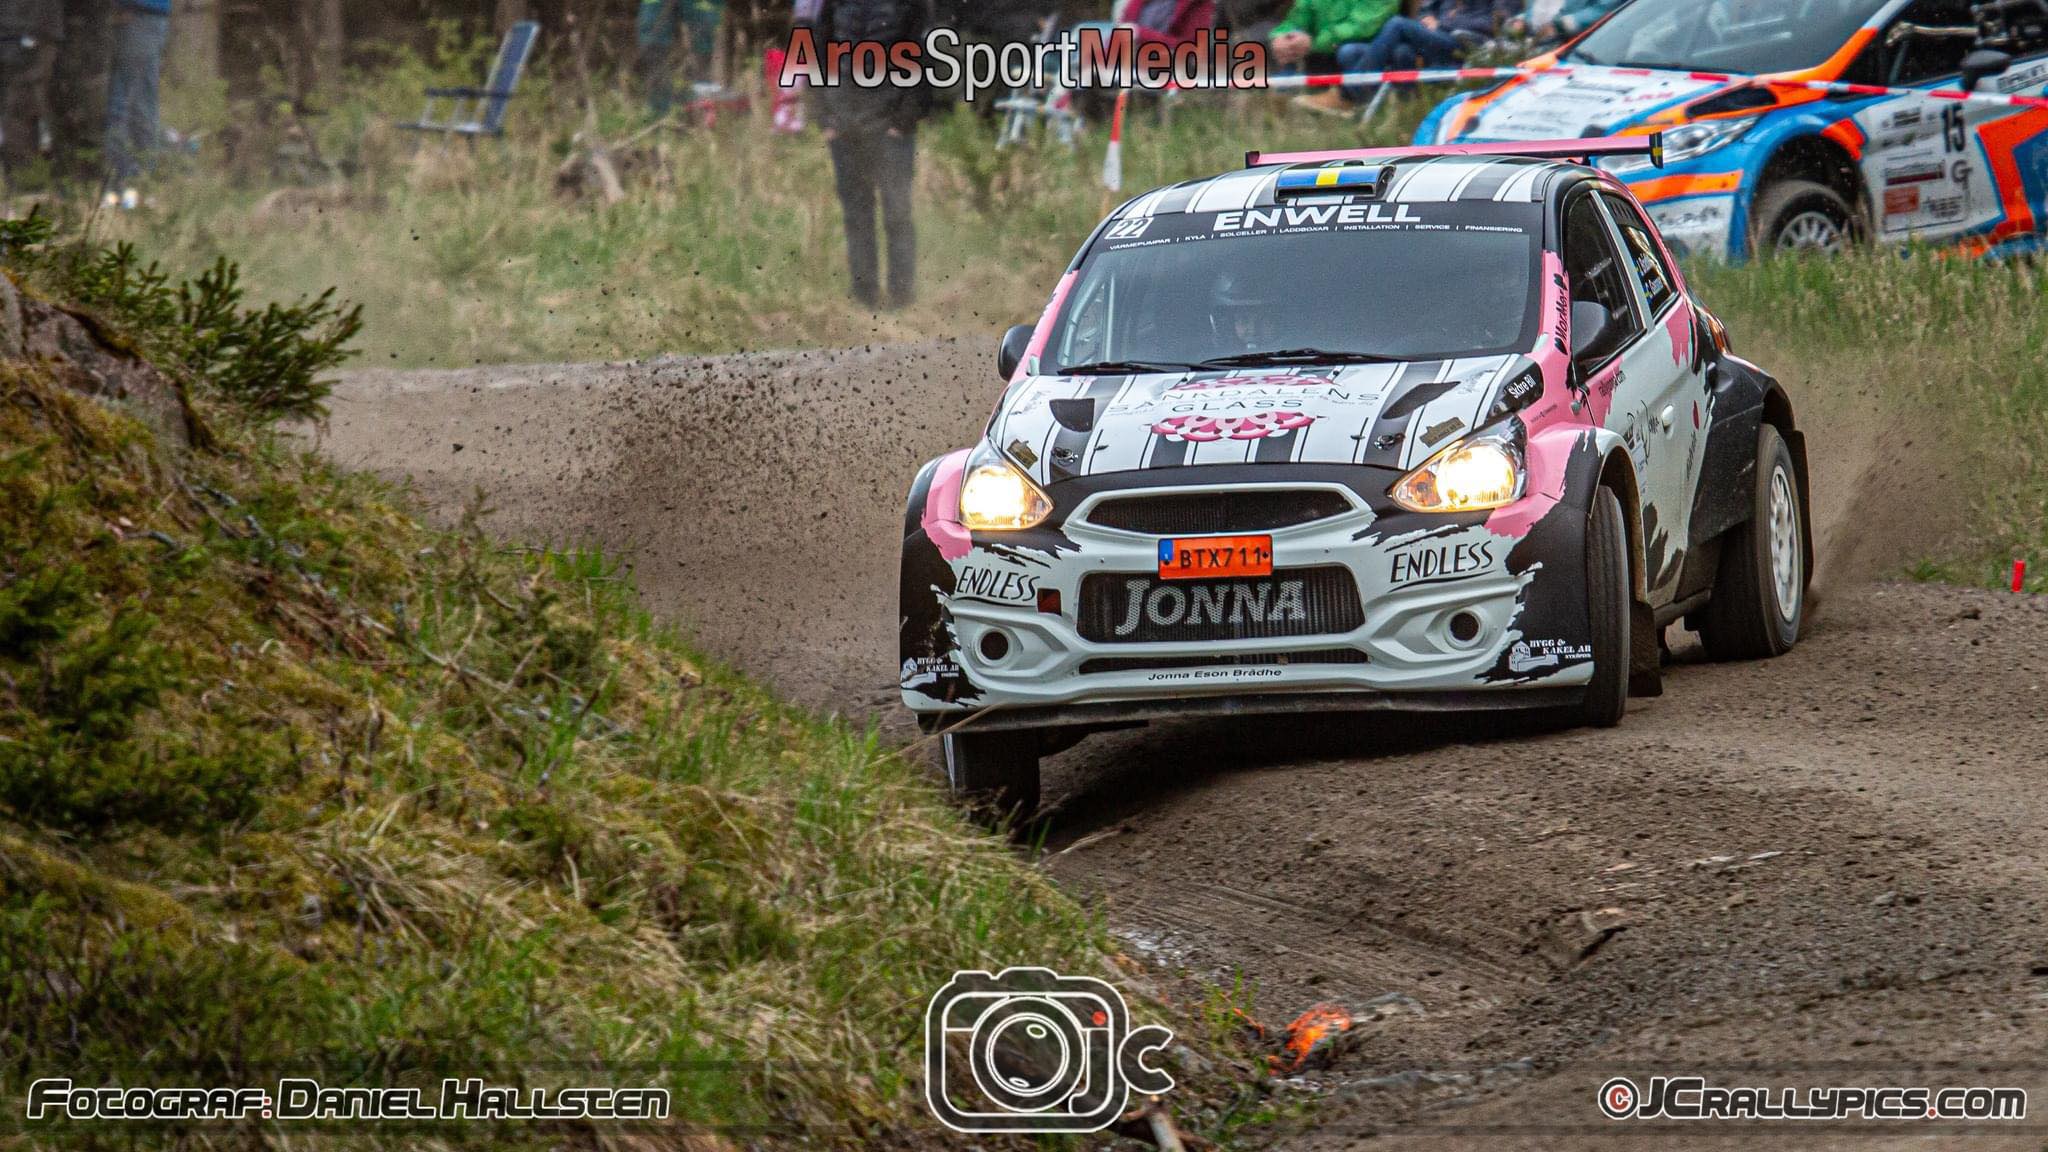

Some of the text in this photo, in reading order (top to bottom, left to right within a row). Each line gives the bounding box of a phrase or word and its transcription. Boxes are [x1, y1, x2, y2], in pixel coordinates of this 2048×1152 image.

[1942, 102, 1966, 152] 15
[1113, 218, 1145, 239] 22
[1213, 204, 1421, 231] ENWELL
[1184, 233, 1206, 241] KYLA
[1219, 228, 1268, 238] SOLCELLER
[1279, 225, 1329, 234] LADDBOXAR
[1464, 225, 1523, 233] FINANSIERING
[1171, 399, 1304, 413] GLASS
[1180, 546, 1261, 570] BTX711
[1390, 540, 1494, 584] ENDLESS
[956, 565, 1041, 602] ENDLESS
[1115, 578, 1306, 636] JONNA
[1530, 639, 1554, 648] BYGG
[1542, 644, 1591, 654] KAKEL AB
[1148, 669, 1190, 681] Jonna
[1194, 669, 1229, 679] Eson
